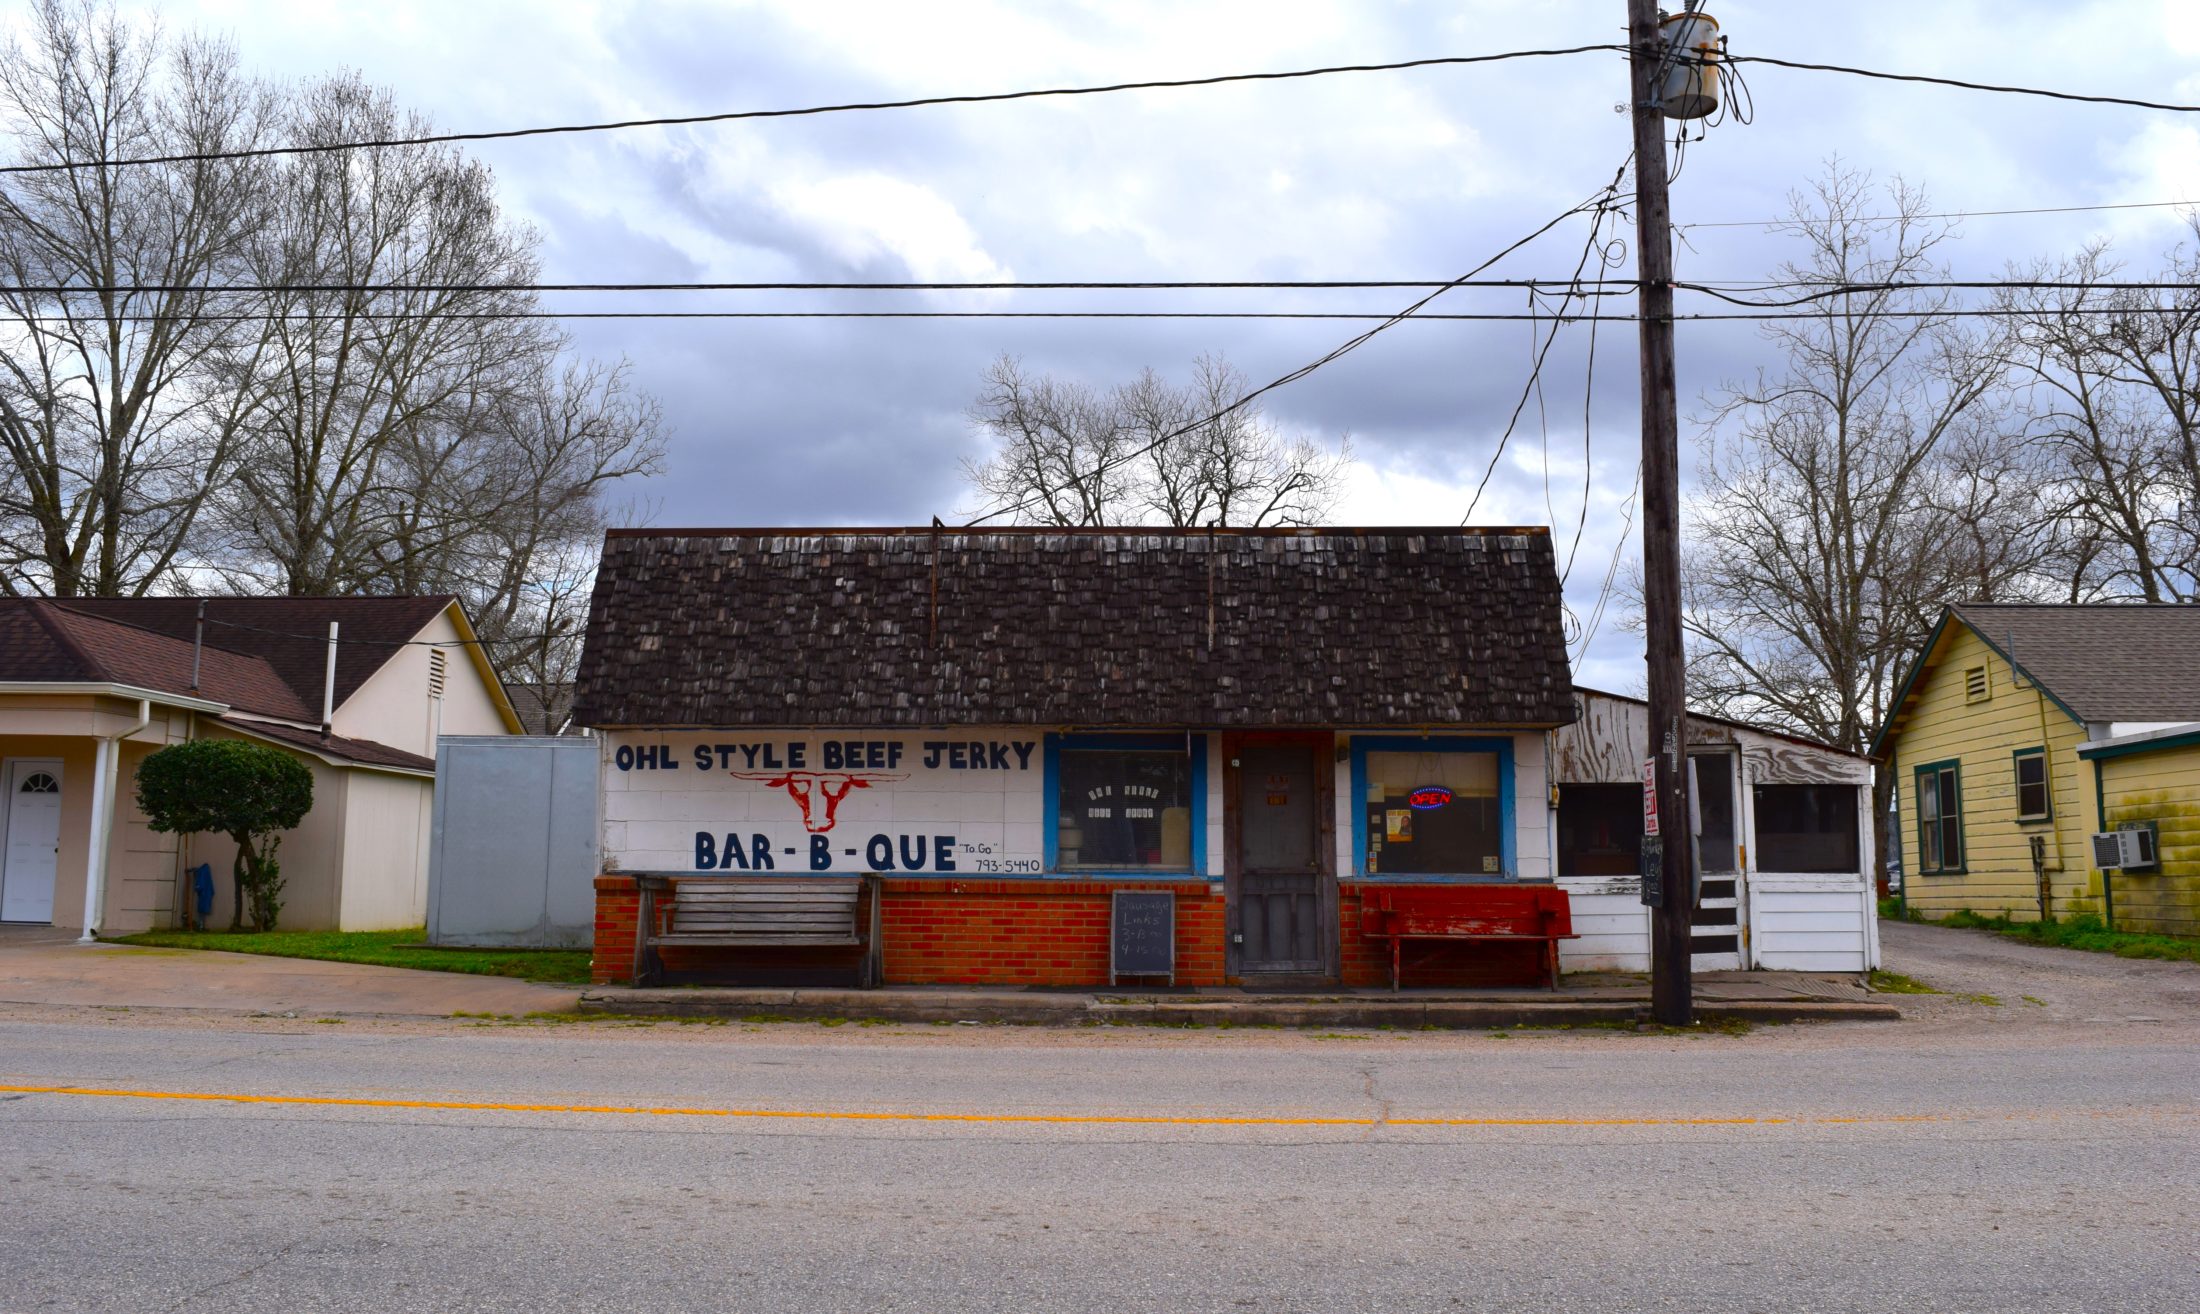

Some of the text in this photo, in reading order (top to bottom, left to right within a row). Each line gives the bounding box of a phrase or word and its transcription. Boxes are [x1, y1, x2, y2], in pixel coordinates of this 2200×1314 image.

[616, 741, 1036, 771] OHL STYLE BEEF JERKY
[1409, 793, 1452, 805] OPEN
[976, 859, 1040, 872] 793-5440
